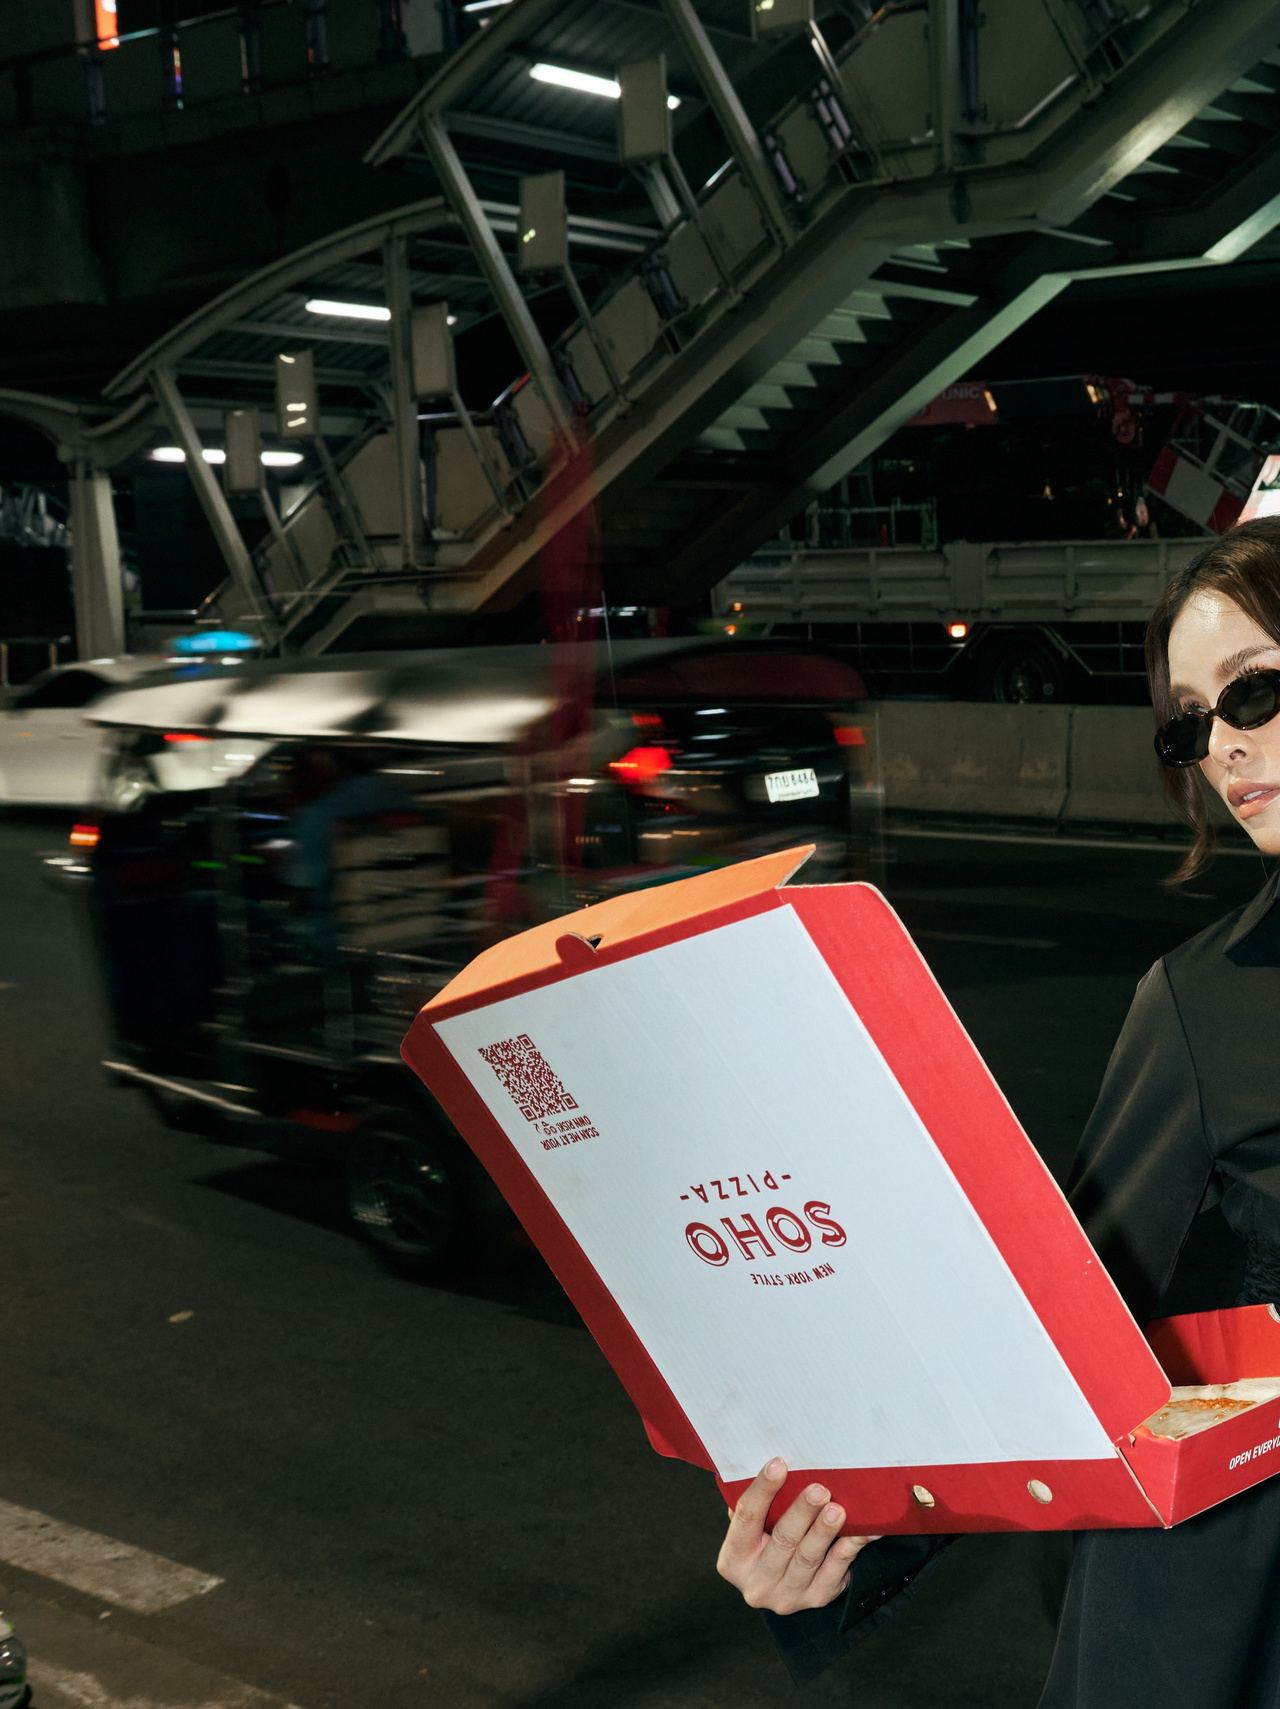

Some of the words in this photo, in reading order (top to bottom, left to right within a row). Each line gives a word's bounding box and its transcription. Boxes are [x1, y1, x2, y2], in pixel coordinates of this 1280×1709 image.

[941, 386, 980, 400] UNIC
[572, 1116, 591, 1128] OWN
[559, 1134, 570, 1146] AT
[568, 1132, 582, 1143] ME
[579, 1127, 599, 1140] SCAN
[540, 1138, 561, 1151] YOUR
[684, 1200, 848, 1268] SOHO
[811, 1262, 836, 1279] NEW
[749, 1273, 784, 1286] STYLE
[784, 1270, 813, 1285] YORK
[1229, 1449, 1252, 1470] OPEN
